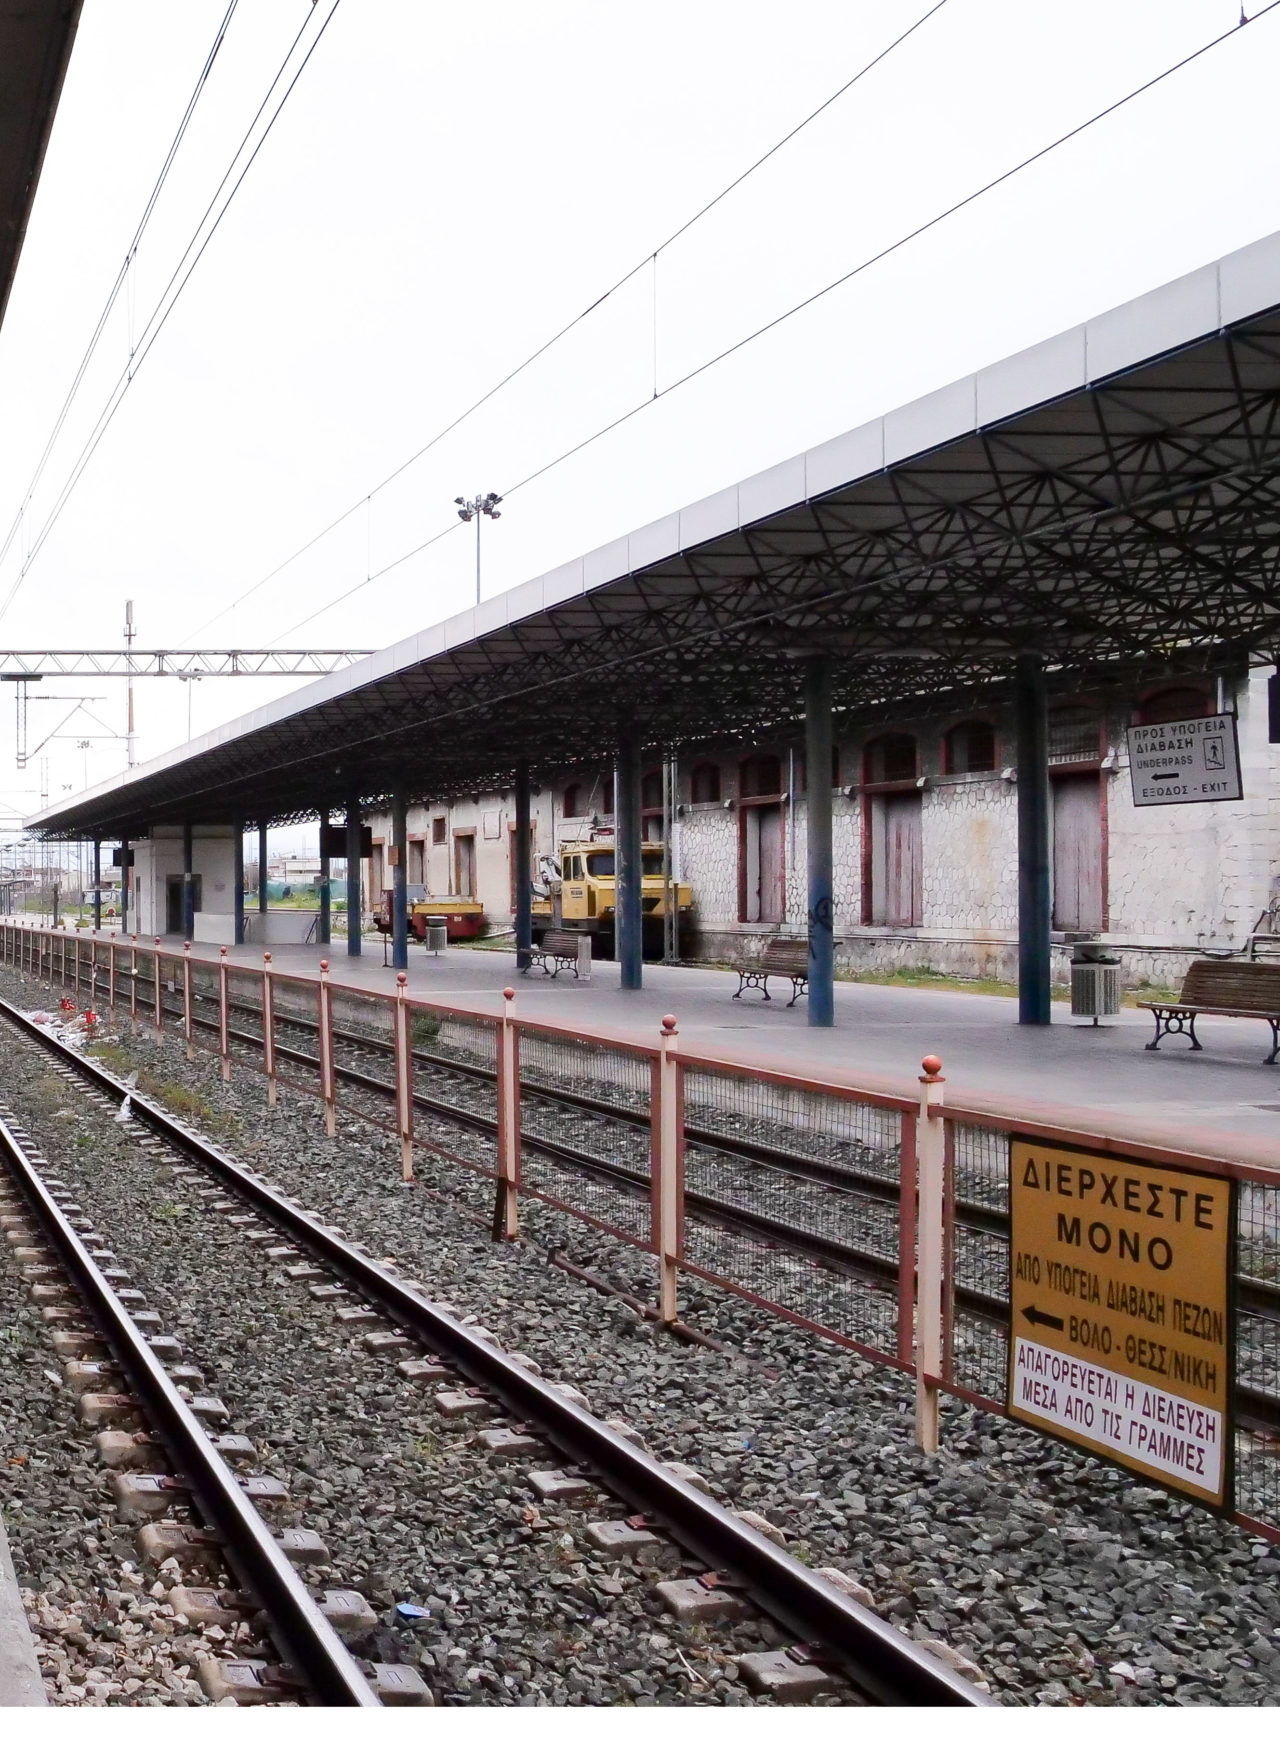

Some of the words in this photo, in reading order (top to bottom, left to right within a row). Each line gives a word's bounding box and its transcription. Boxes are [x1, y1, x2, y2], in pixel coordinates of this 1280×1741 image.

[1134, 728, 1166, 741] ΠΡΟΣ
[1170, 720, 1226, 737] ΥΠΟΓΕΙΑ
[1136, 738, 1193, 754] ΔΙΑΒΑΣΗ
[1136, 755, 1194, 769] UNDERPASS
[1142, 785, 1189, 798] ΕΞΟΔΟΣ
[1201, 782, 1228, 793] EXIT
[1022, 1158, 1214, 1230] ΔΙΕΡΧΕΣΤΕ
[1057, 1213, 1173, 1270] ΜΟΝΟ
[1016, 1252, 1041, 1282] ΑΠΟ
[1046, 1259, 1100, 1303] ΥΠΟΓΕΙΑ
[1106, 1280, 1166, 1325] ΔΙΑΒΑΣΗ
[1173, 1300, 1223, 1346] ΠΕΖΩΝ
[1069, 1315, 1113, 1356] ΒΟΛΟ
[1125, 1333, 1217, 1394] ΘΕΣΣ/ΝΙΚΗ
[1017, 1344, 1118, 1403] ΑΠΑΓΟΡΕΥΕΤΑΙ
[1125, 1386, 1135, 1411] Η
[1142, 1390, 1216, 1444] ΔΙΕΛΕΥΣΗ
[1022, 1377, 1058, 1413] ΜΕΣΑ
[1064, 1390, 1094, 1428] ΑΠΟ
[1102, 1407, 1122, 1441] ΤΙΣ
[1129, 1419, 1206, 1476] ΓΡΑΜΜΕΣ
